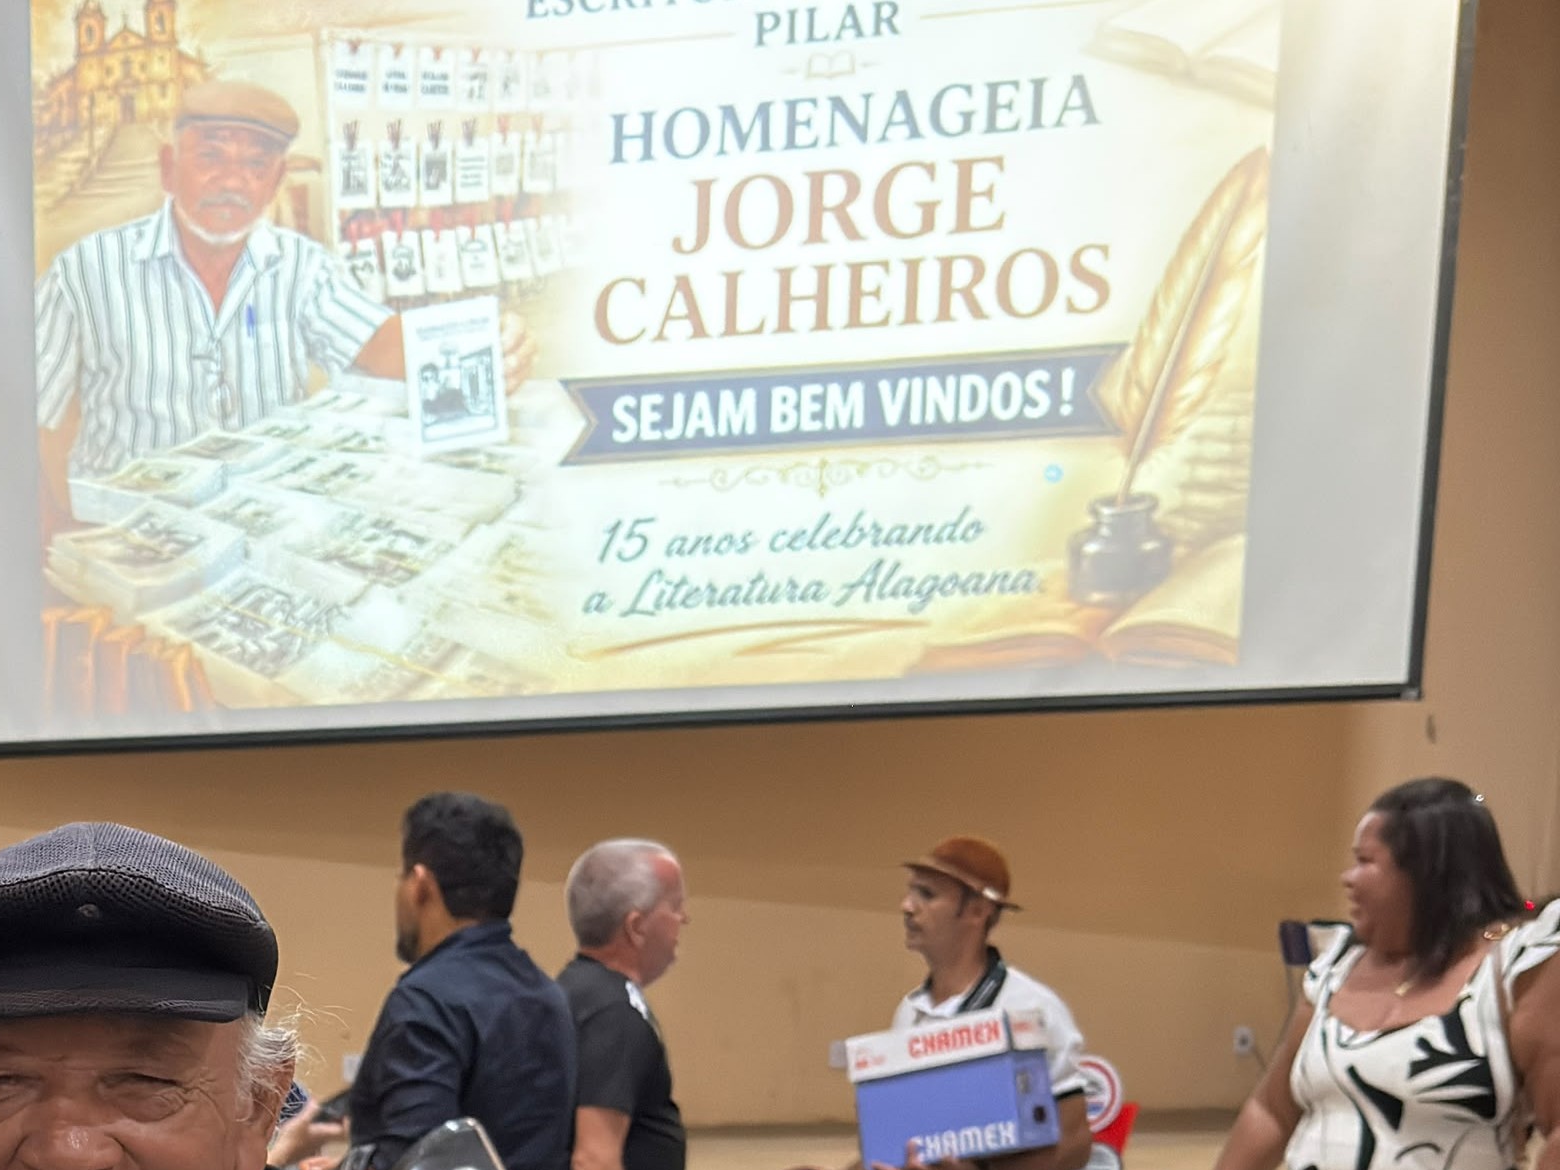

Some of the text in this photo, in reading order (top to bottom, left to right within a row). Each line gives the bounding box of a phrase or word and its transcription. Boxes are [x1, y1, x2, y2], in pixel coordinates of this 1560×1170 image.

[753, 1, 901, 47] PILAR
[609, 73, 1101, 164] HOMENAGEIA
[672, 156, 1007, 256] JORGE
[593, 243, 1113, 347] CALHEIROS
[611, 388, 758, 443] SEJAM
[768, 384, 867, 431] BEM
[877, 369, 1050, 427] VINDOS
[598, 506, 987, 563] 15 anos celebrando
[582, 586, 614, 615] a
[619, 569, 830, 618] Literatura
